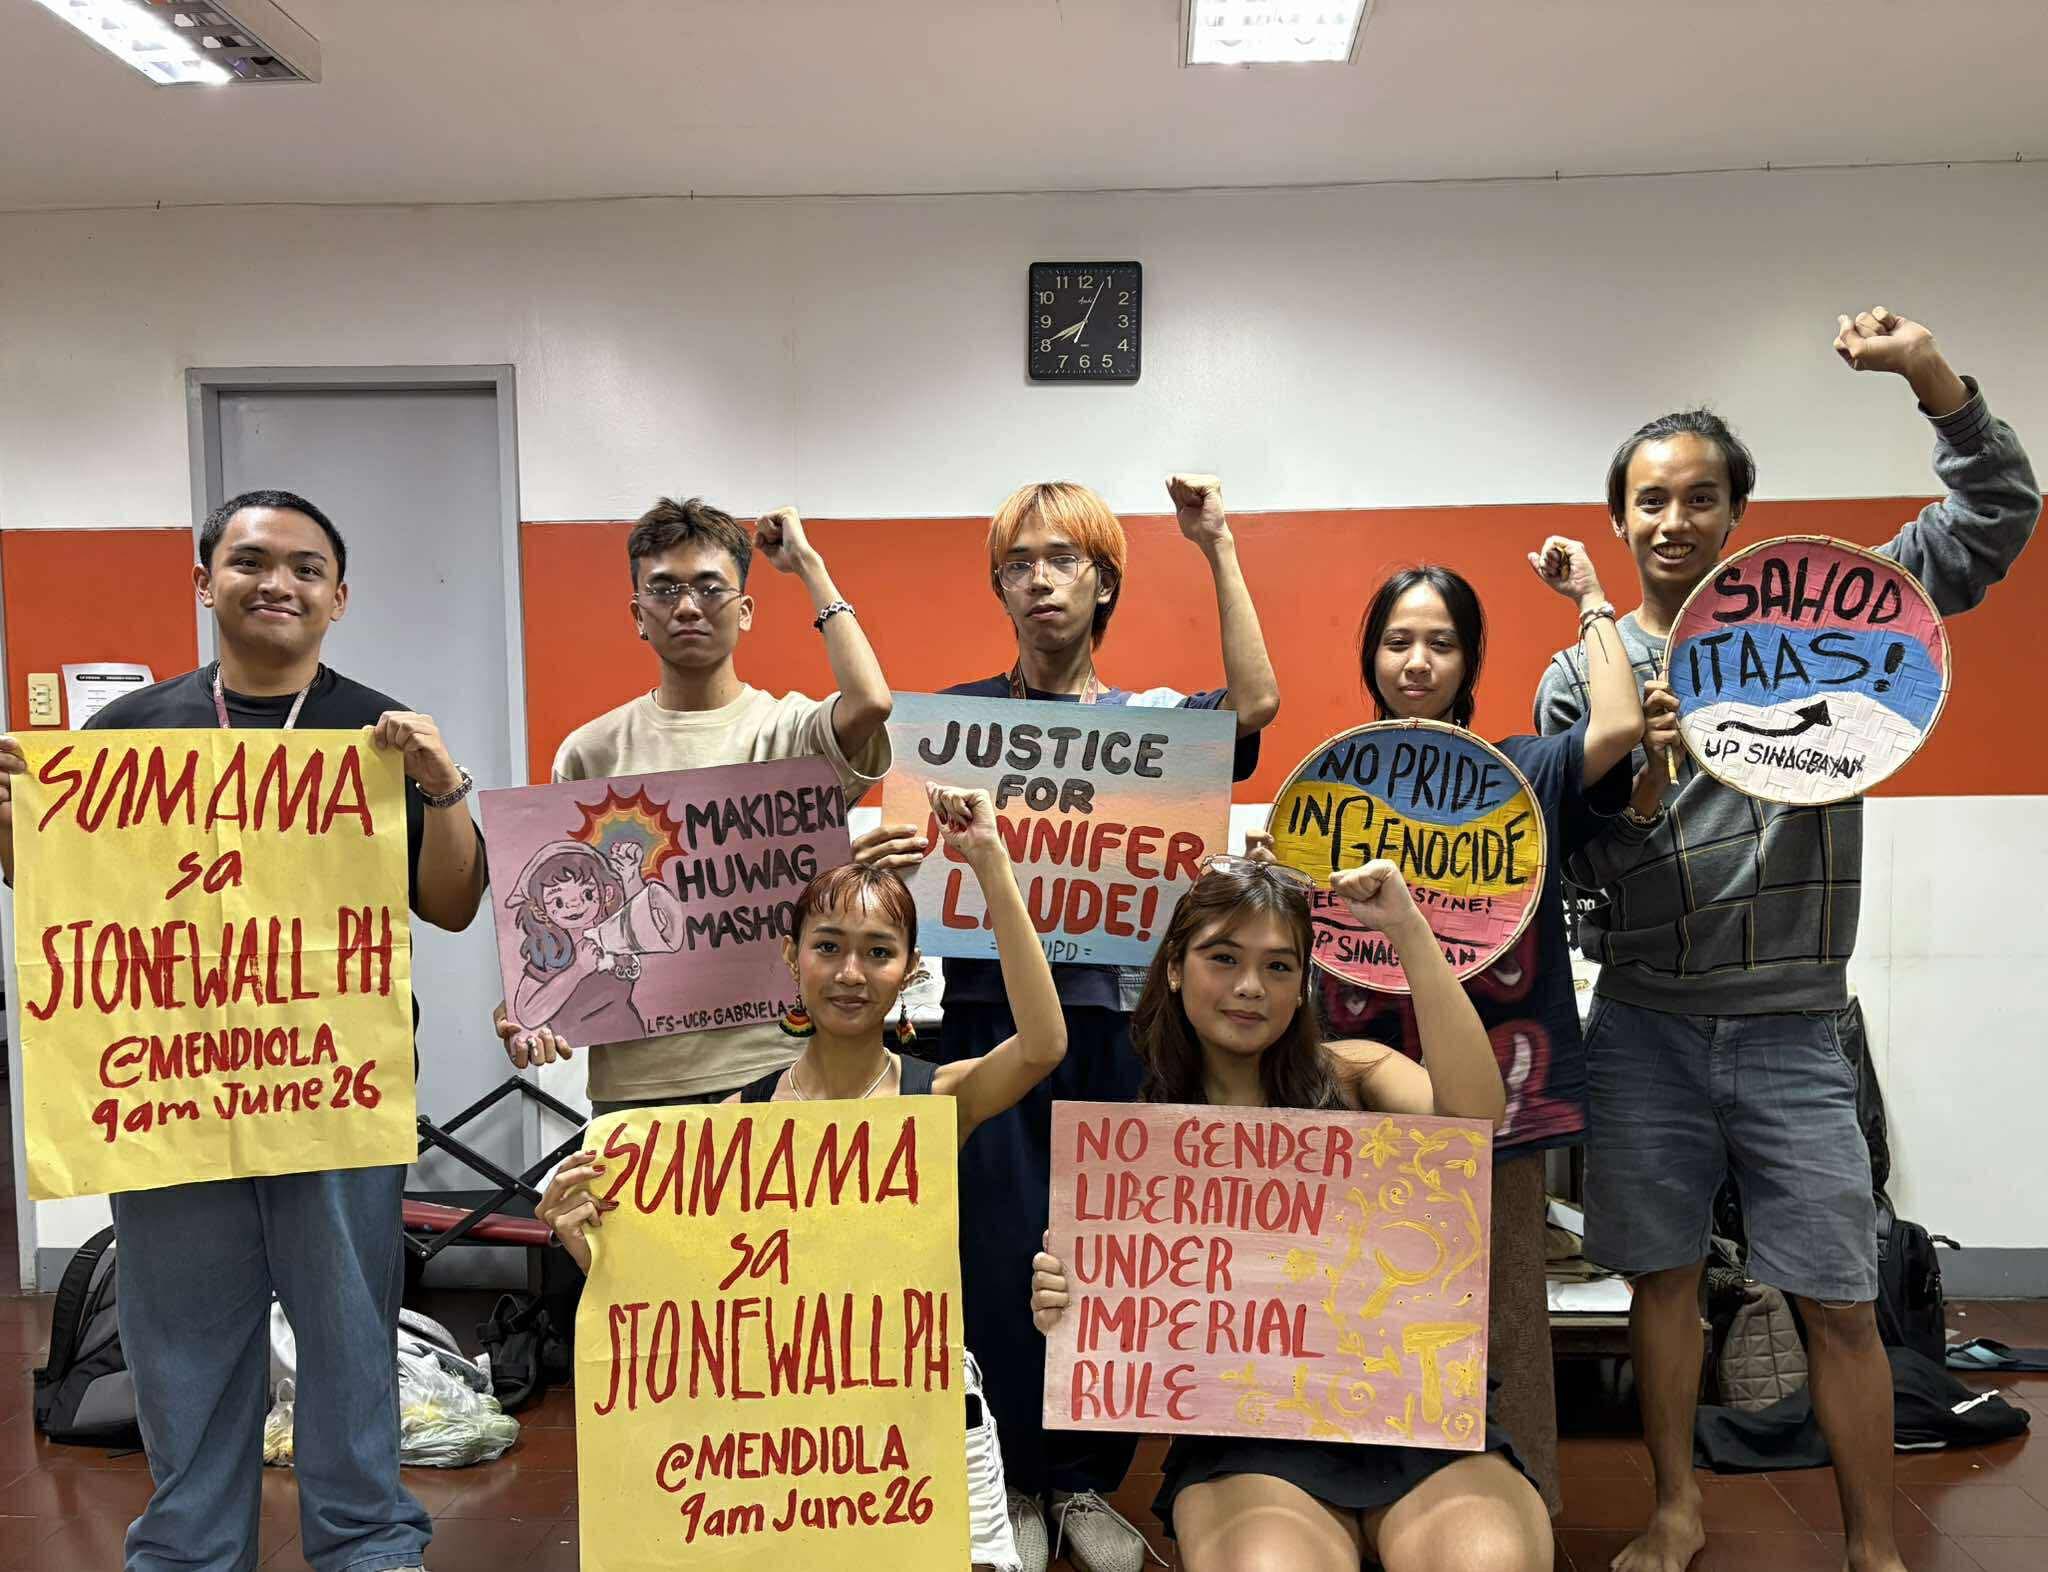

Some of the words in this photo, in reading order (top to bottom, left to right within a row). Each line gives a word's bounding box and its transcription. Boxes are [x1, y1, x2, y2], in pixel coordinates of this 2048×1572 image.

[1040, 291, 1054, 304] 10
[1078, 276, 1093, 288] 12
[1118, 292, 1129, 305] 2
[1041, 315, 1051, 328] 9
[1117, 338, 1129, 352] 4
[1118, 315, 1129, 328] 3
[1058, 355, 1068, 368] 7
[1079, 355, 1090, 368] 6
[1102, 355, 1112, 368] 5
[1712, 557, 1902, 625] SAHOD
[1690, 632, 1905, 697] ITAAS!
[918, 720, 1169, 778] JUSTICE
[1318, 743, 1379, 785] NO
[1388, 743, 1500, 811] PRIDE
[1704, 740, 1740, 761] UP
[1744, 743, 1866, 779] SINAGBAYAN
[38, 741, 375, 837] SUMAMA
[684, 785, 847, 851] MAKIBEKI
[995, 774, 1094, 814] FOR
[922, 811, 1205, 881] JNNIFER
[1288, 792, 1332, 836] IN
[1329, 796, 1530, 885] GENOCIDE
[164, 849, 242, 900] sa
[675, 844, 818, 902] HUWAG
[942, 868, 1159, 942] LUDE!
[26, 916, 320, 1020] STONEWALL
[336, 905, 393, 997] PH
[99, 1023, 338, 1088] @MENDIOLA
[91, 1098, 200, 1142] 9am
[213, 1081, 321, 1121] June
[333, 1060, 382, 1109] 26
[602, 1117, 919, 1217] SUMAMA
[1076, 1117, 1149, 1163] NO
[1173, 1118, 1354, 1178] GENDER
[1074, 1171, 1327, 1236] LIBERATION
[719, 1228, 790, 1291] sa
[1074, 1232, 1233, 1294] UNDER
[594, 1292, 898, 1416] STONEWALL
[904, 1288, 949, 1393] PH
[1077, 1295, 1326, 1358] IMPERIAL
[1071, 1360, 1199, 1422] RULE
[656, 1424, 909, 1493] @MENDIOLA
[680, 1493, 764, 1545] 9am
[772, 1489, 880, 1532] June
[885, 1476, 933, 1526] 26
